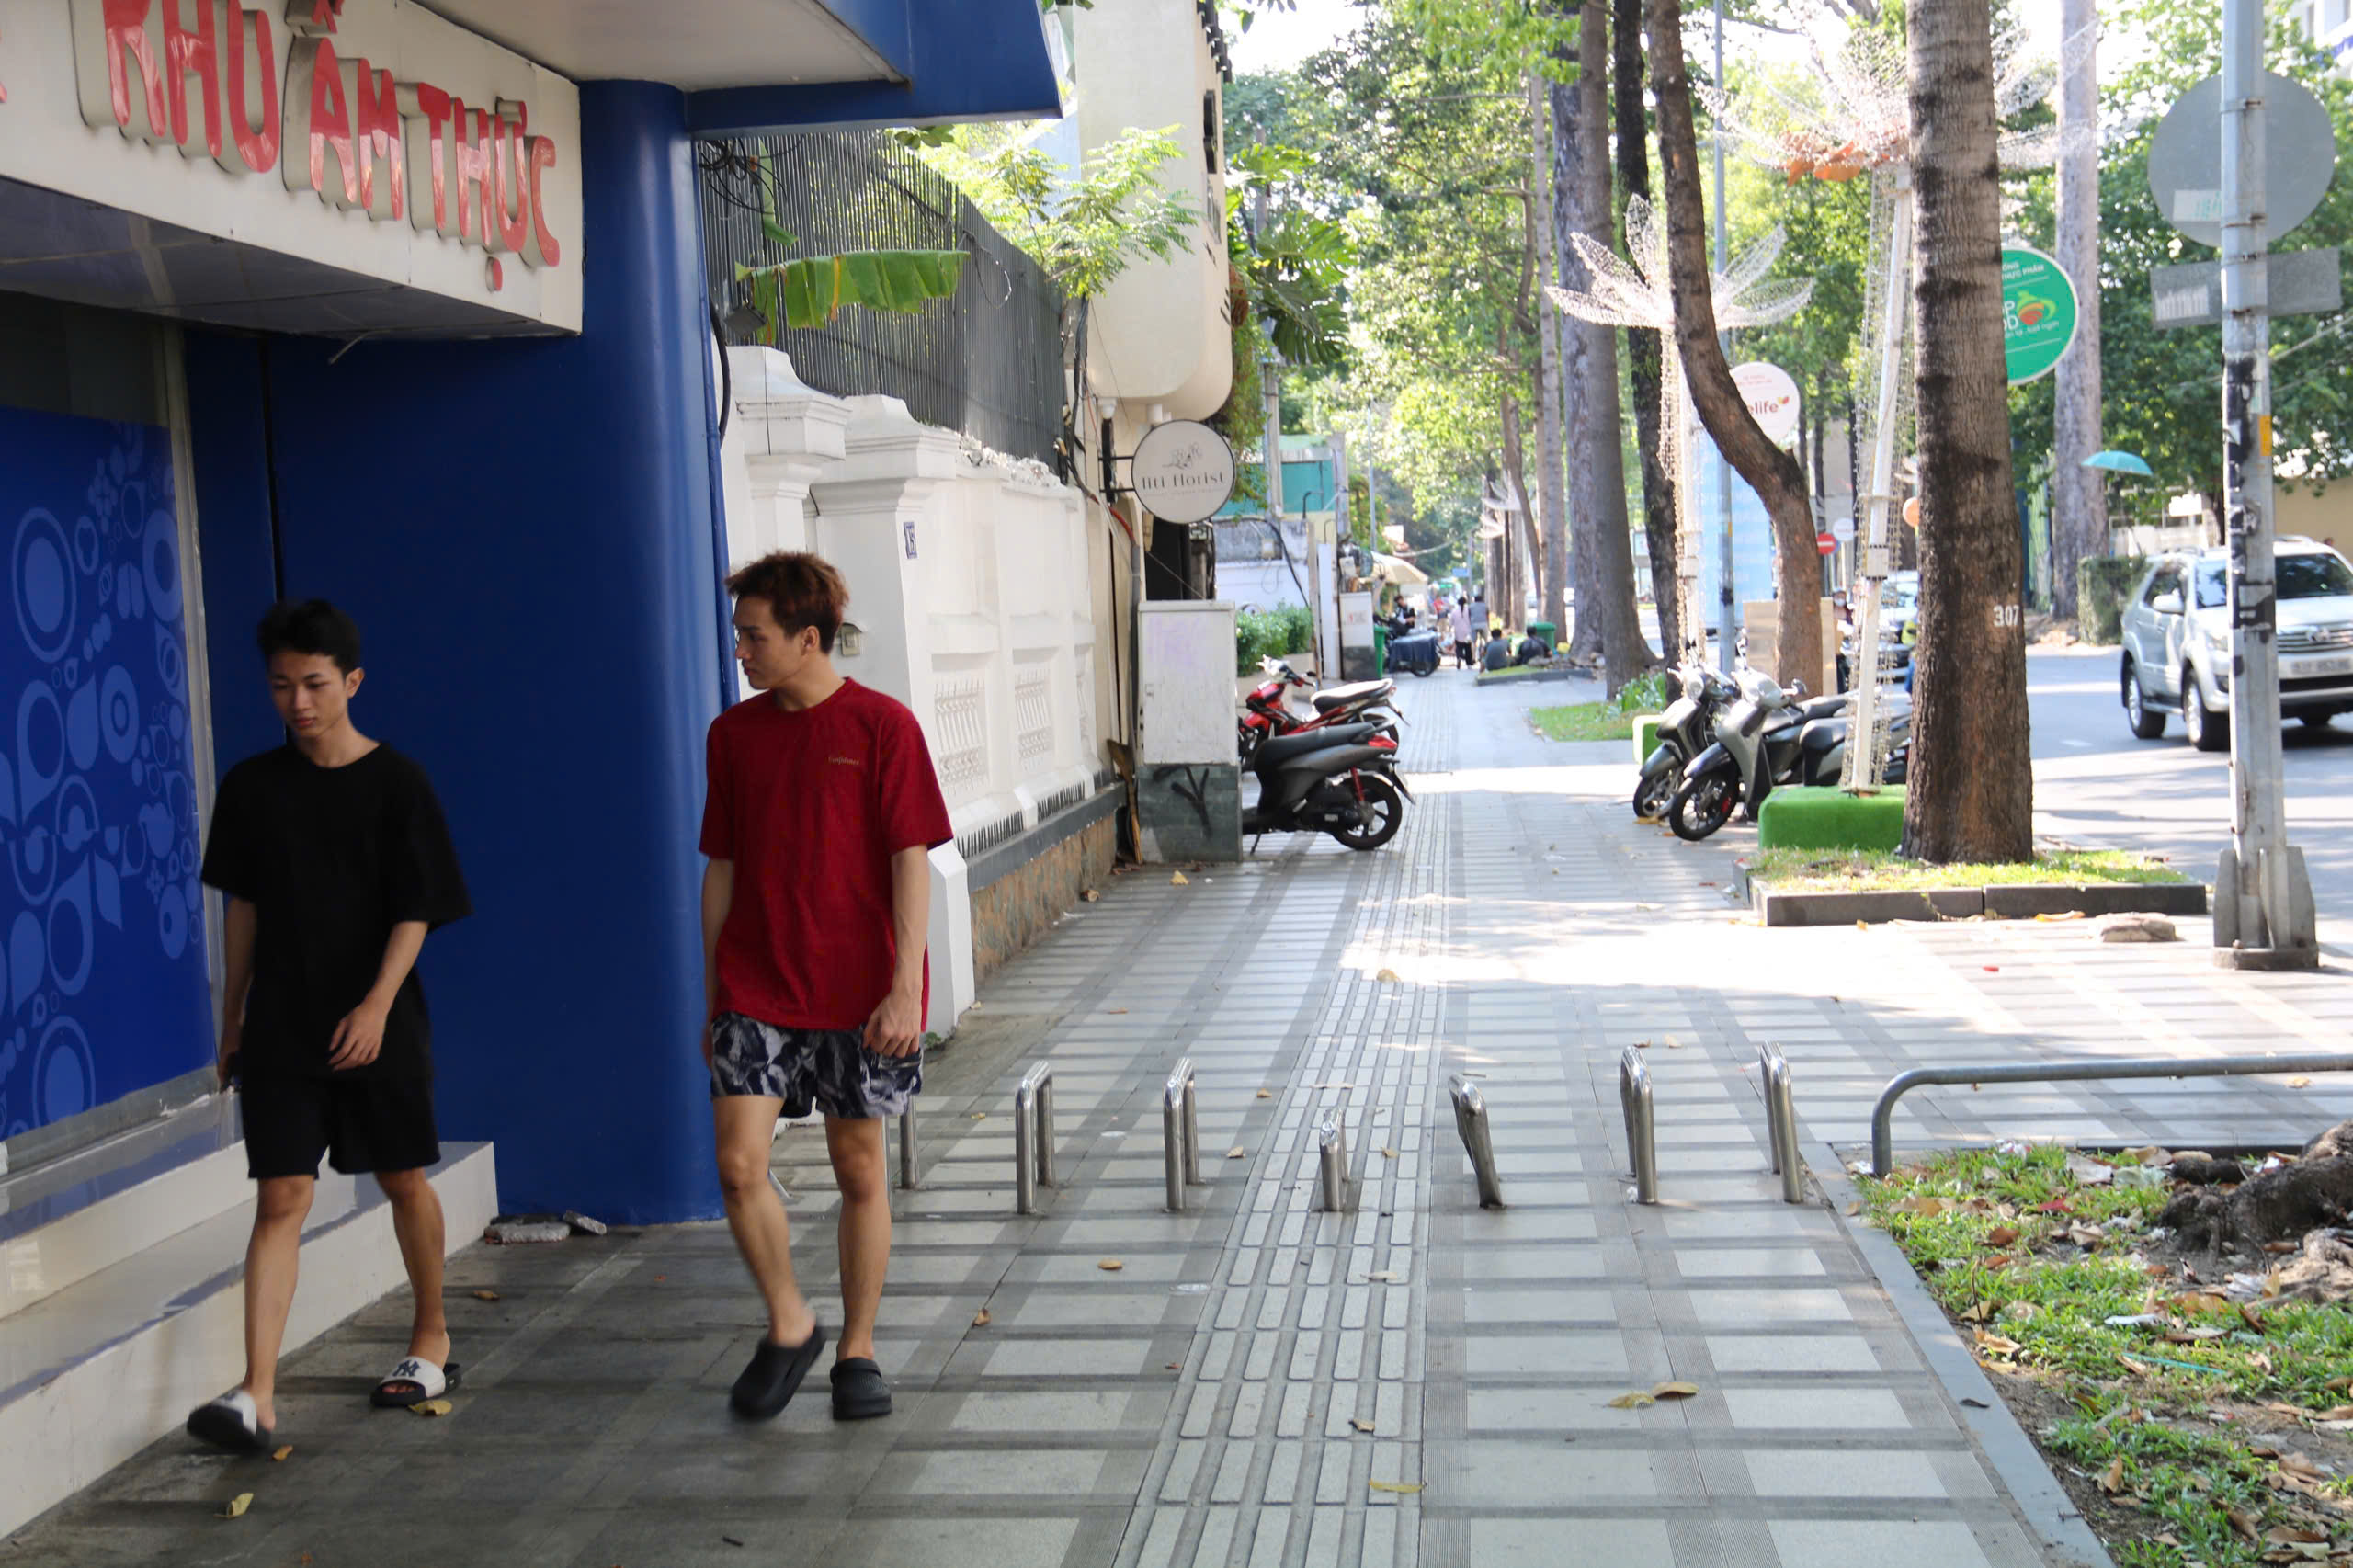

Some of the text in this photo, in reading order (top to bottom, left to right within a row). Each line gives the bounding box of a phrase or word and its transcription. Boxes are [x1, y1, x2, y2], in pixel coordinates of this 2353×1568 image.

[101, 0, 280, 174] KHU
[417, 81, 561, 292] THỰC
[1993, 605, 2020, 628] 307
